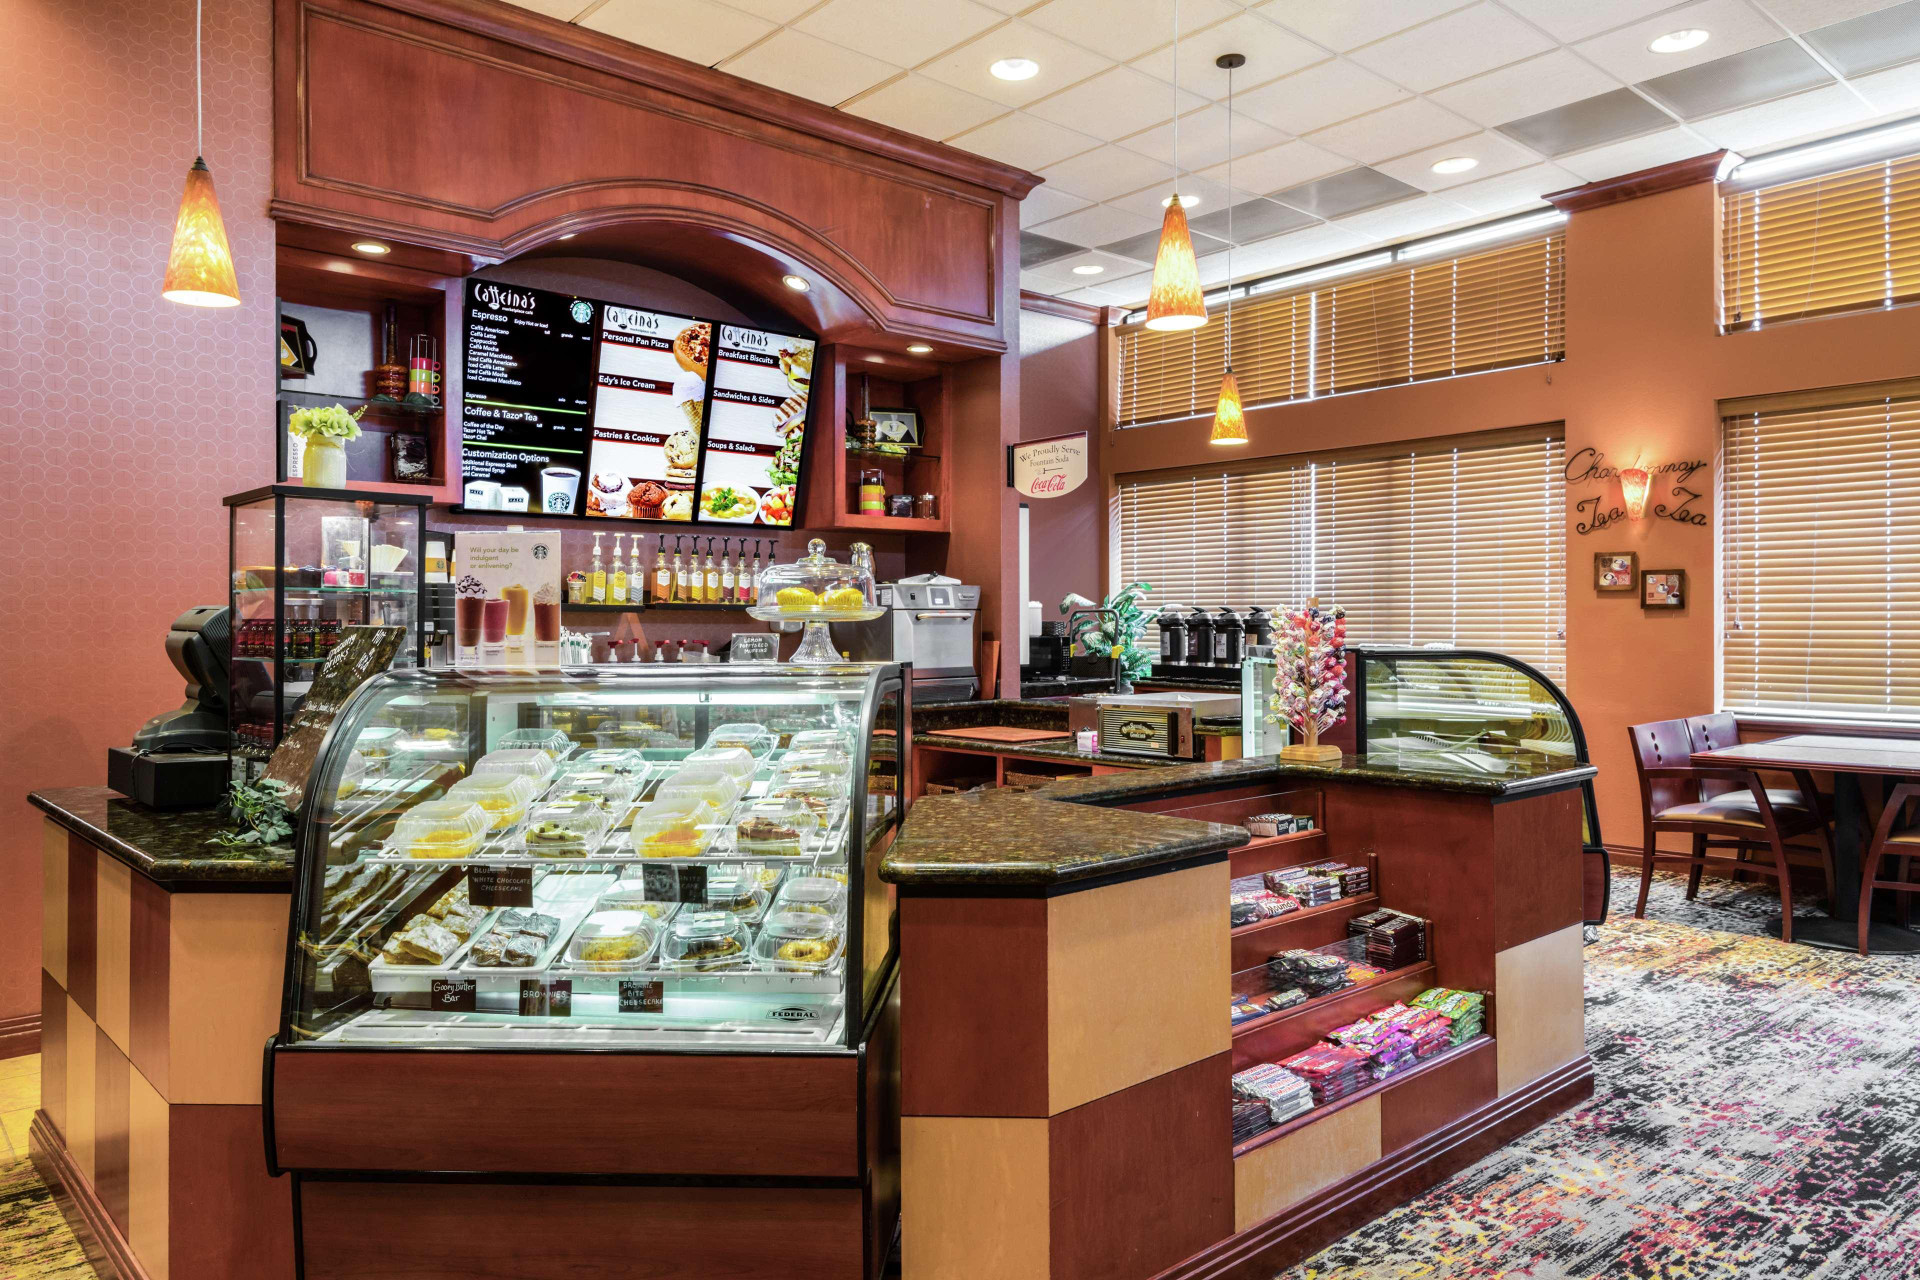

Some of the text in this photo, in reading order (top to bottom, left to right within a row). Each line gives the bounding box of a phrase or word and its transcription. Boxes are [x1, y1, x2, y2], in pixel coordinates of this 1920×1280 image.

[474, 283, 536, 310] Caffeina's
[471, 308, 508, 323] Espresso
[484, 327, 510, 335] Americano
[469, 337, 498, 346] Cappuccino
[603, 332, 669, 348] Personal Pan Pizza
[489, 352, 513, 360] Macchiato
[718, 349, 773, 365] Breakfast Biscuits
[492, 359, 518, 367] Americano
[498, 378, 522, 386] Macchiato
[600, 376, 656, 390] Edy's Ice Cream
[465, 391, 487, 400] Espresso
[713, 390, 750, 402] Sandwiches
[759, 396, 775, 405] Sides
[464, 406, 492, 417] Coffee
[493, 409, 501, 418] &
[524, 412, 538, 421] Tea
[594, 430, 660, 443] Pastries & Cookies
[707, 441, 727, 450] Soups
[462, 448, 550, 463] Customization Options
[1019, 444, 1081, 463] We Proudly Serve
[1030, 455, 1069, 467] Fountain Soda
[1576, 496, 1624, 535] Tea
[496, 877, 531, 885] CHOCOLATE
[480, 884, 522, 892] CHEESECAKE
[1267, 901, 1297, 915] Mounds
[454, 981, 476, 992] Butter
[441, 993, 461, 1003] Bar
